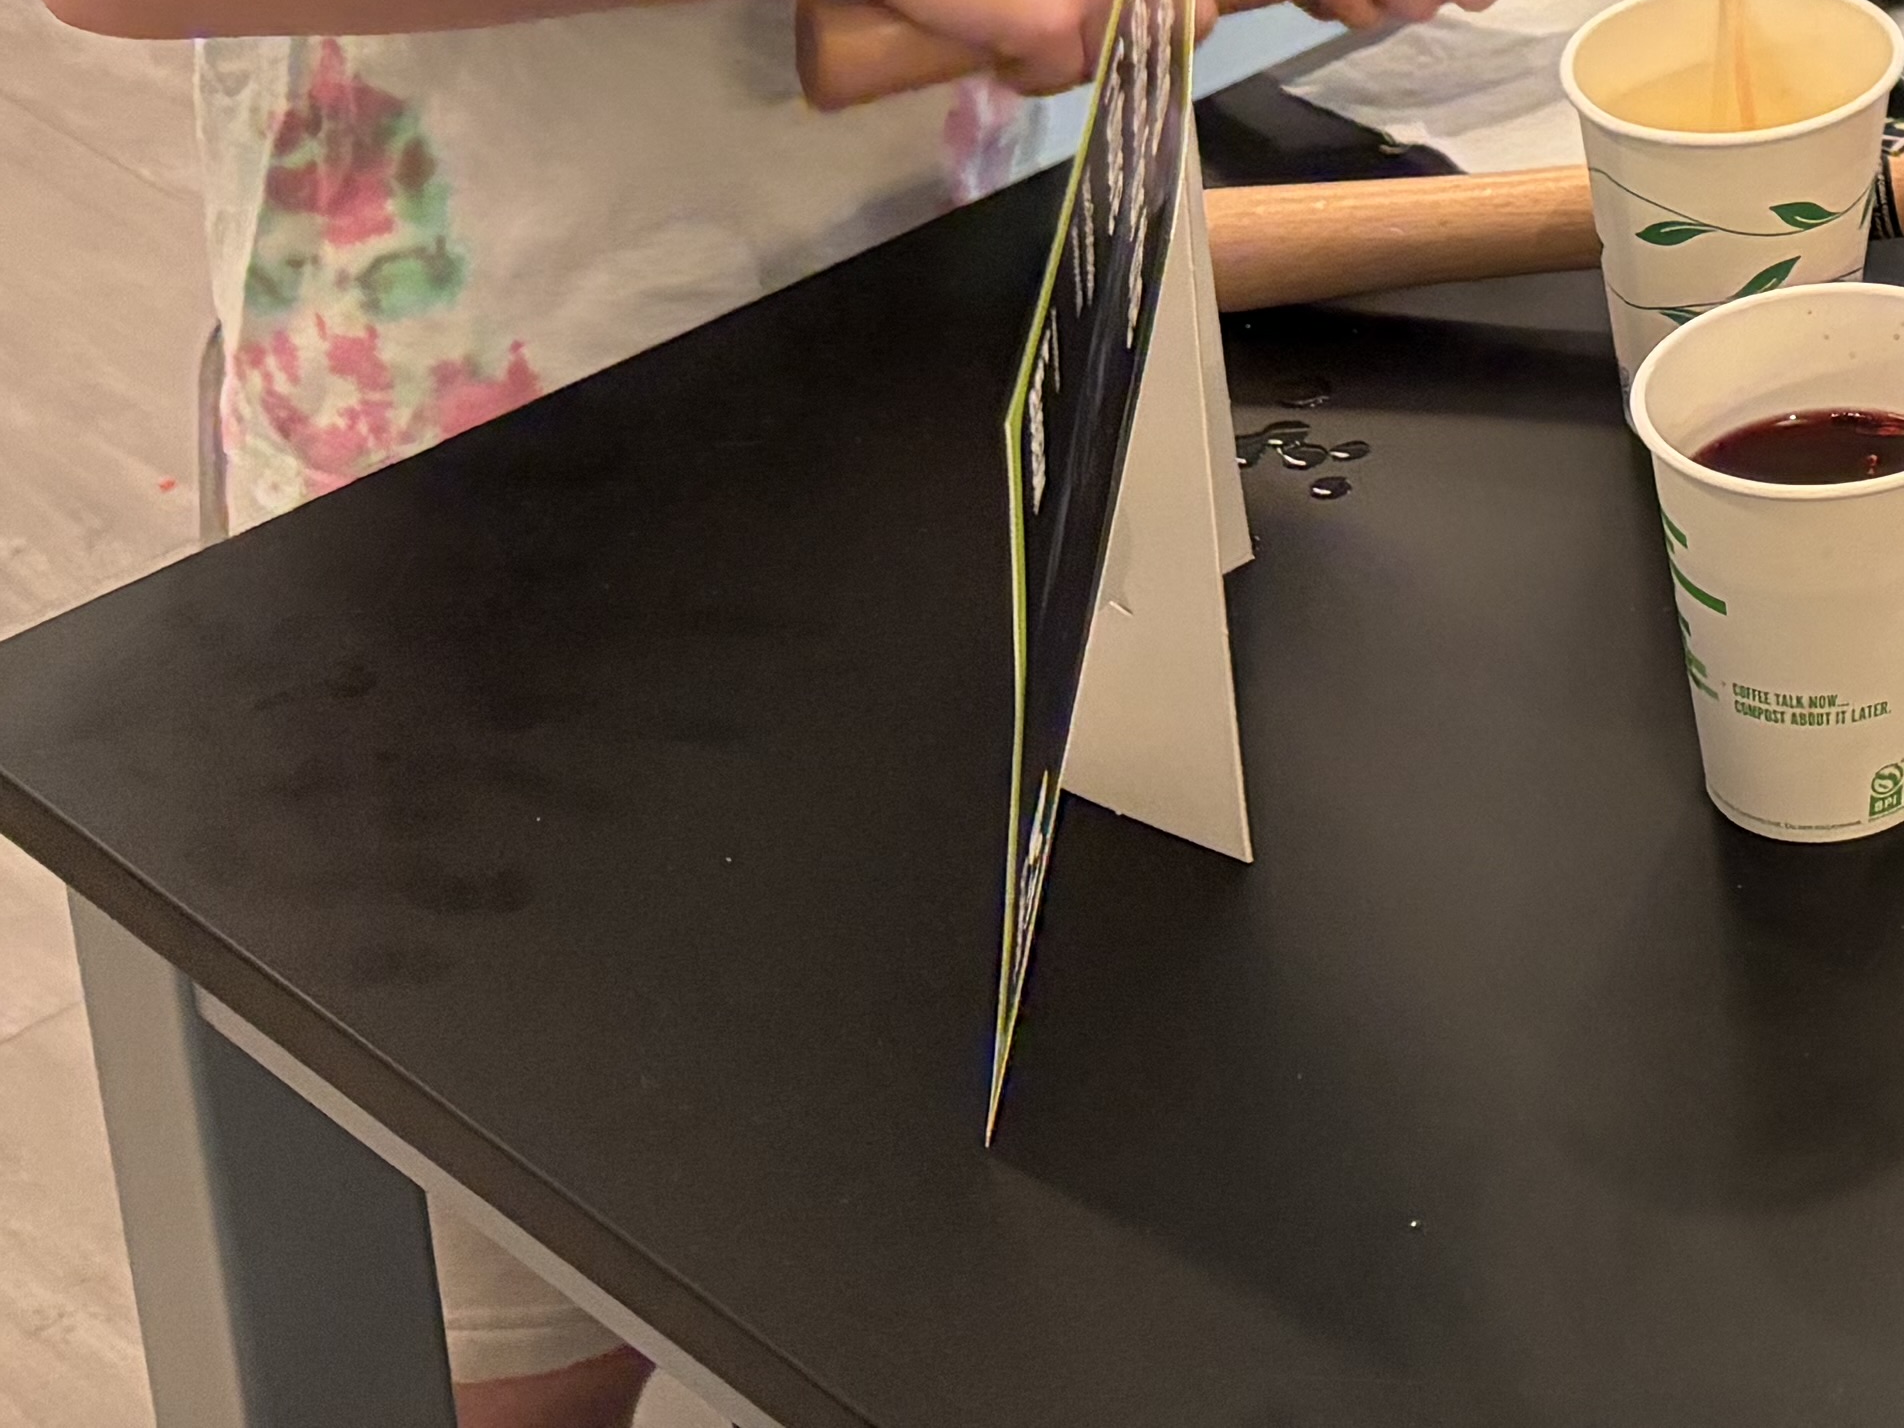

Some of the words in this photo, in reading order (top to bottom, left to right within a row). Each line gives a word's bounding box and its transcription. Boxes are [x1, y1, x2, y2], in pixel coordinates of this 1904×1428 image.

[1732, 682, 1770, 706] COFFEE
[1774, 692, 1805, 709] TALK
[1734, 699, 1786, 724] COMPOST
[1790, 711, 1832, 726] ABOUT
[1835, 710, 1846, 725] IT
[1873, 794, 1898, 812] BPI
